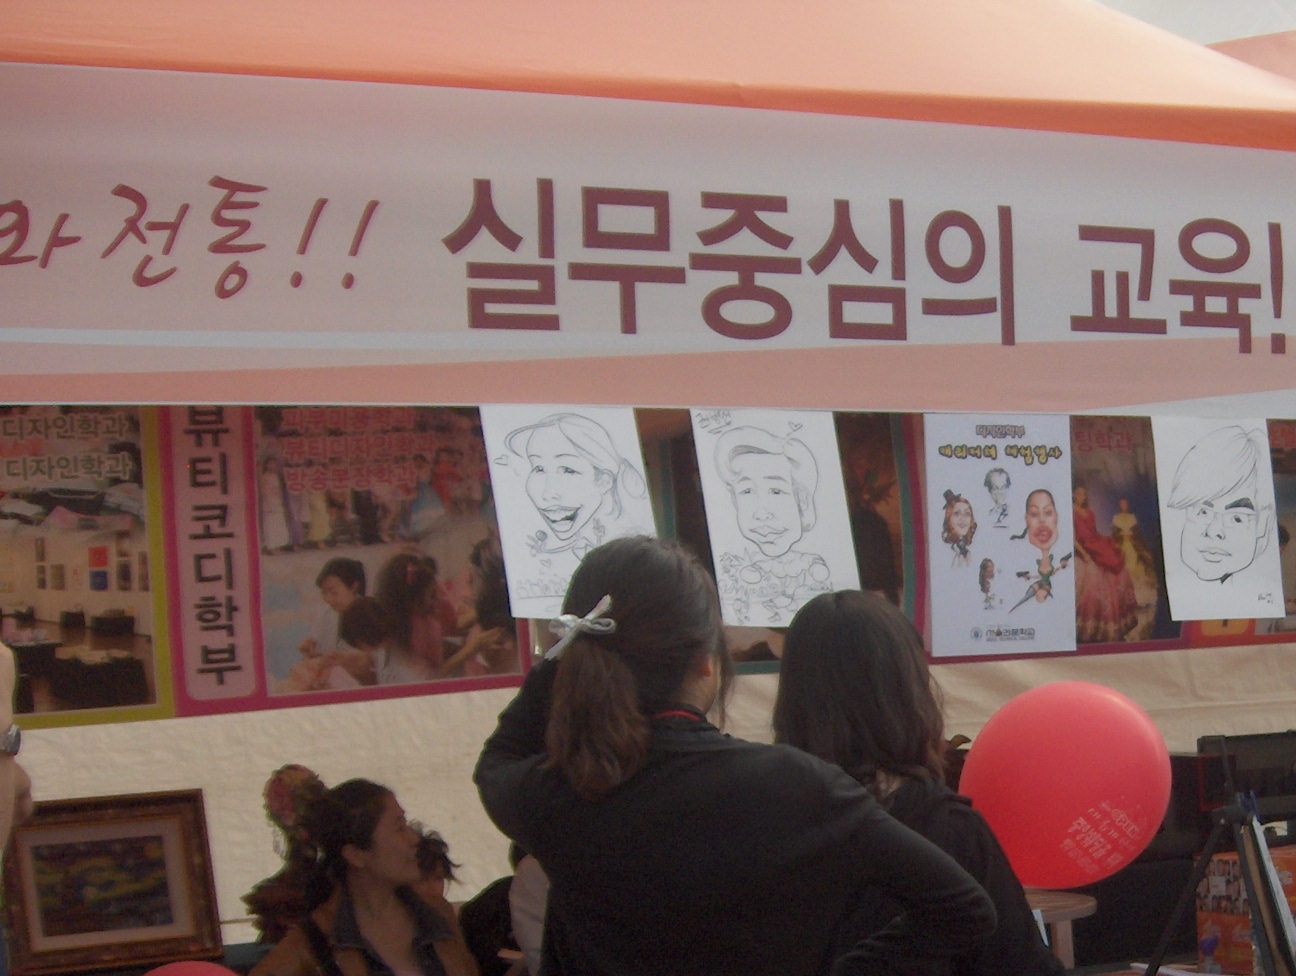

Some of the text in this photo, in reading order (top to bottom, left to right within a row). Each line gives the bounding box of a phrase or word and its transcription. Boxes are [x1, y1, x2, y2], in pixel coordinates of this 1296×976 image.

[101, 175, 381, 299] 전통!!
[441, 177, 1016, 346] 실무중심의
[1069, 217, 1286, 354] 교육!
[2, 415, 128, 440] 디자인학과
[5, 454, 133, 480] 디자인학과
